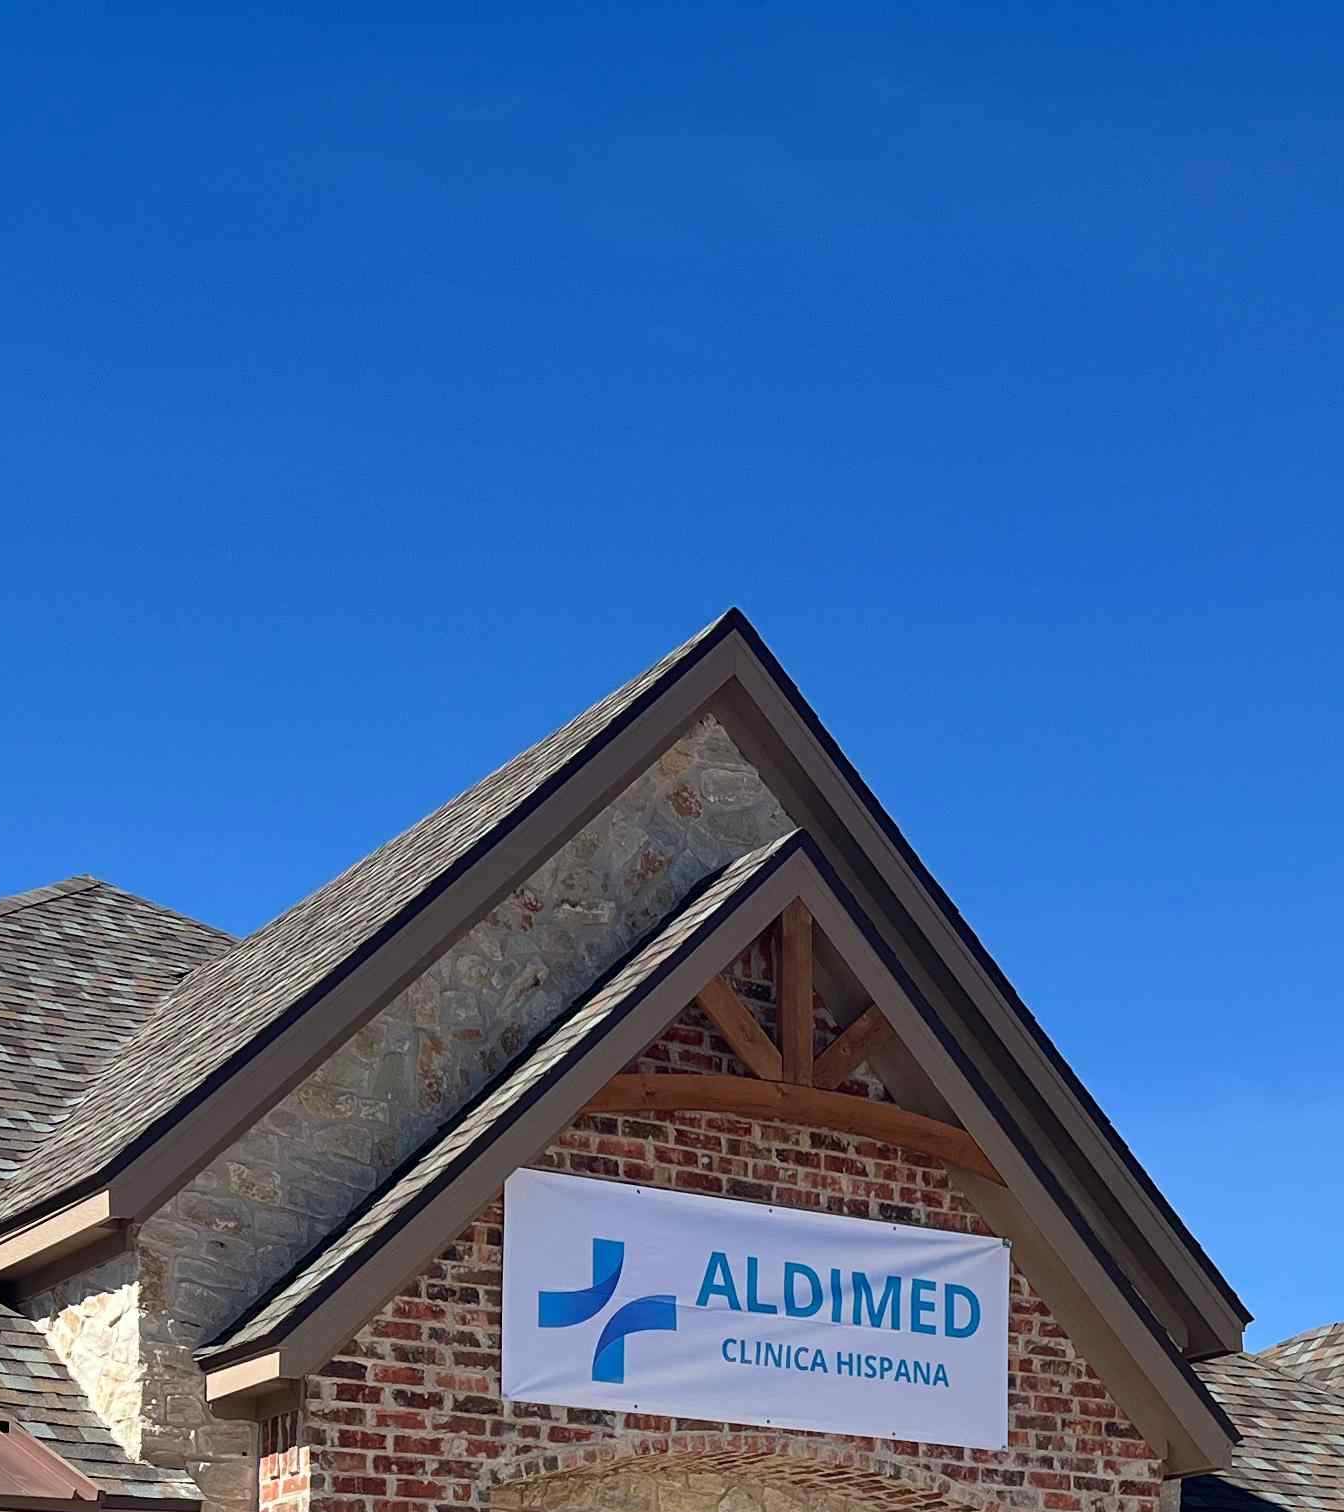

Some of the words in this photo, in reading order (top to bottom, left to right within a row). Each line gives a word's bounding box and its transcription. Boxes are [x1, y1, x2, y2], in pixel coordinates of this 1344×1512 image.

[696, 1251, 981, 1338] ALDIMED
[722, 1338, 828, 1374] CLINICA
[836, 1351, 950, 1388] HISPANA
